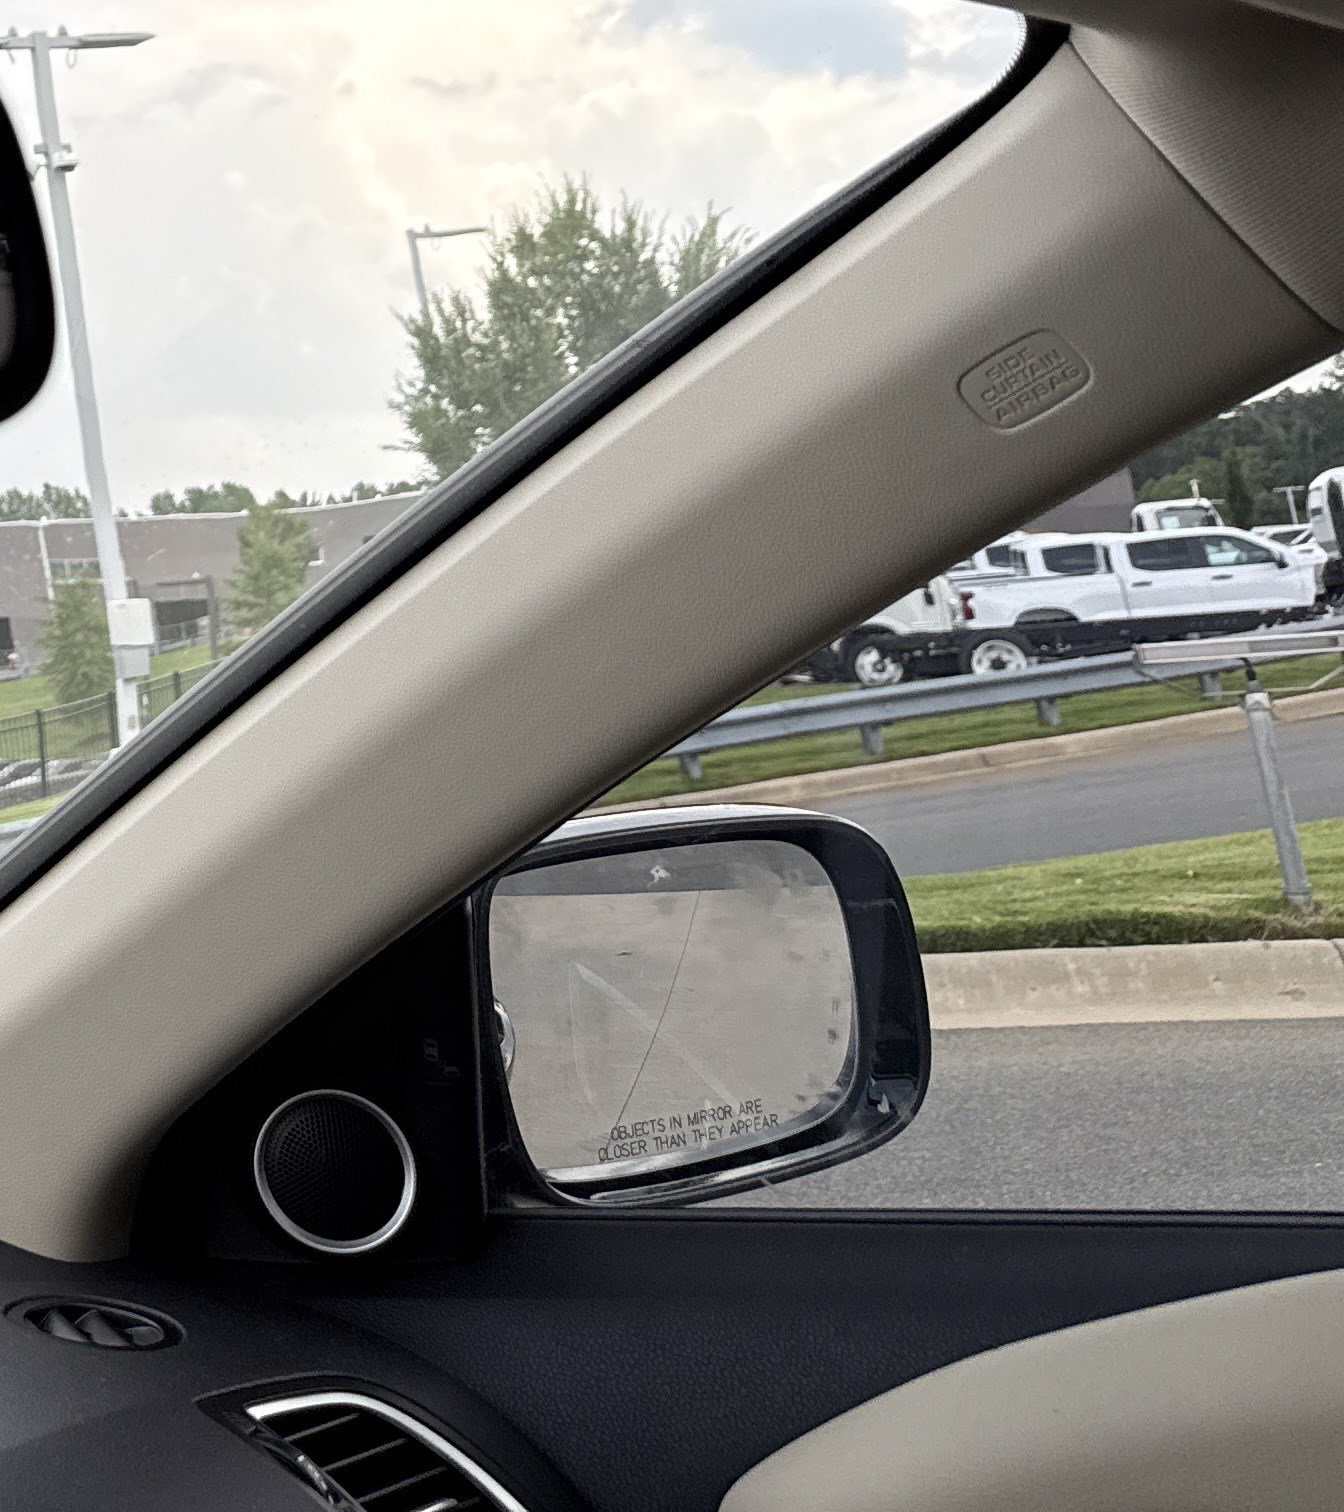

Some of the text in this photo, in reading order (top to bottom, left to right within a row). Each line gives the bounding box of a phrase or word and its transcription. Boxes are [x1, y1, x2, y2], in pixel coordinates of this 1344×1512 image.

[980, 349, 1066, 403] CURTAIN
[985, 347, 1035, 380] SIDE
[995, 366, 1081, 421] AIRBAG
[598, 1113, 779, 1163] CLOSER THAN THEY APPEAR
[611, 1098, 764, 1142] OBJECTS IN MIRROR ARE
